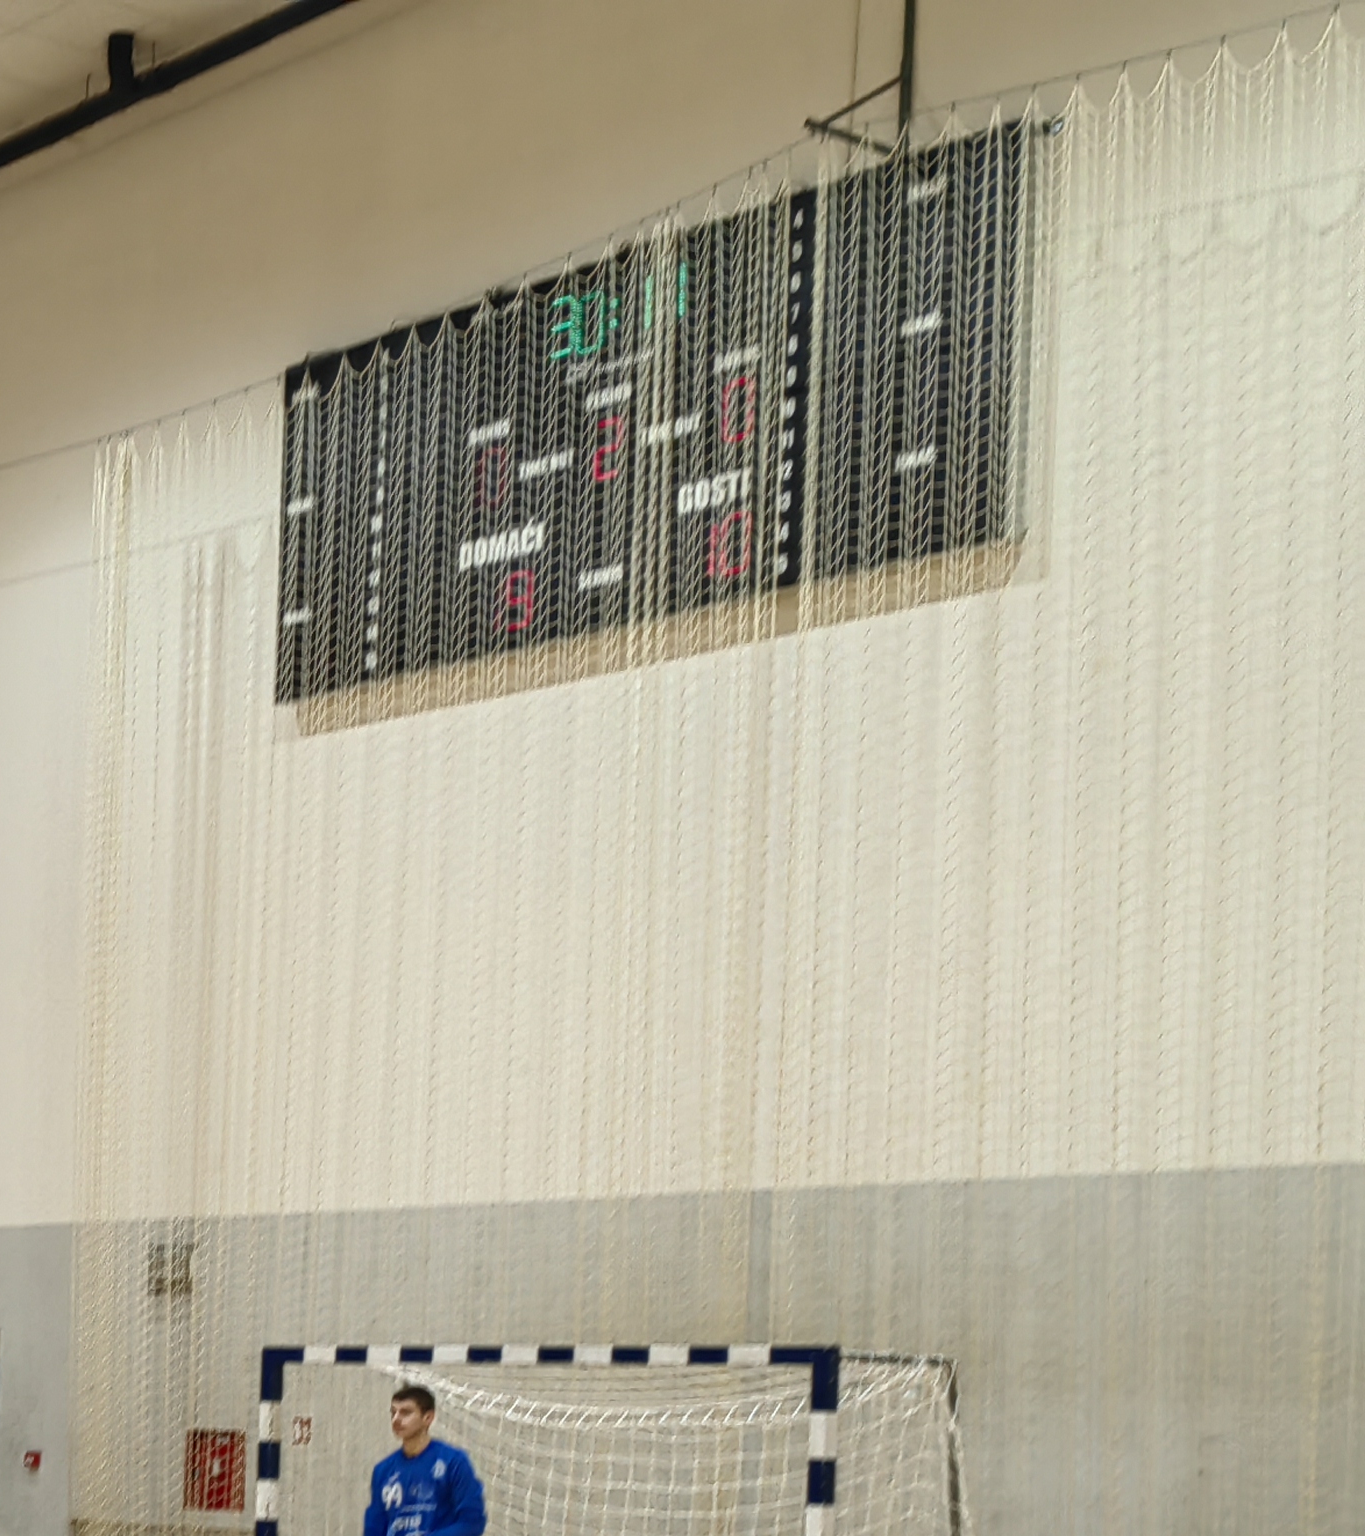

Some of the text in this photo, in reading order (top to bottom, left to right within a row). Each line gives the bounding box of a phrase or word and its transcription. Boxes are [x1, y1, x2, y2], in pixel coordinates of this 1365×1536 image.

[592, 416, 624, 483] 2
[677, 466, 751, 515] GOSTI
[458, 516, 546, 573] DOMAĆI
[707, 510, 753, 579] 10
[381, 1480, 403, 1511] 99
